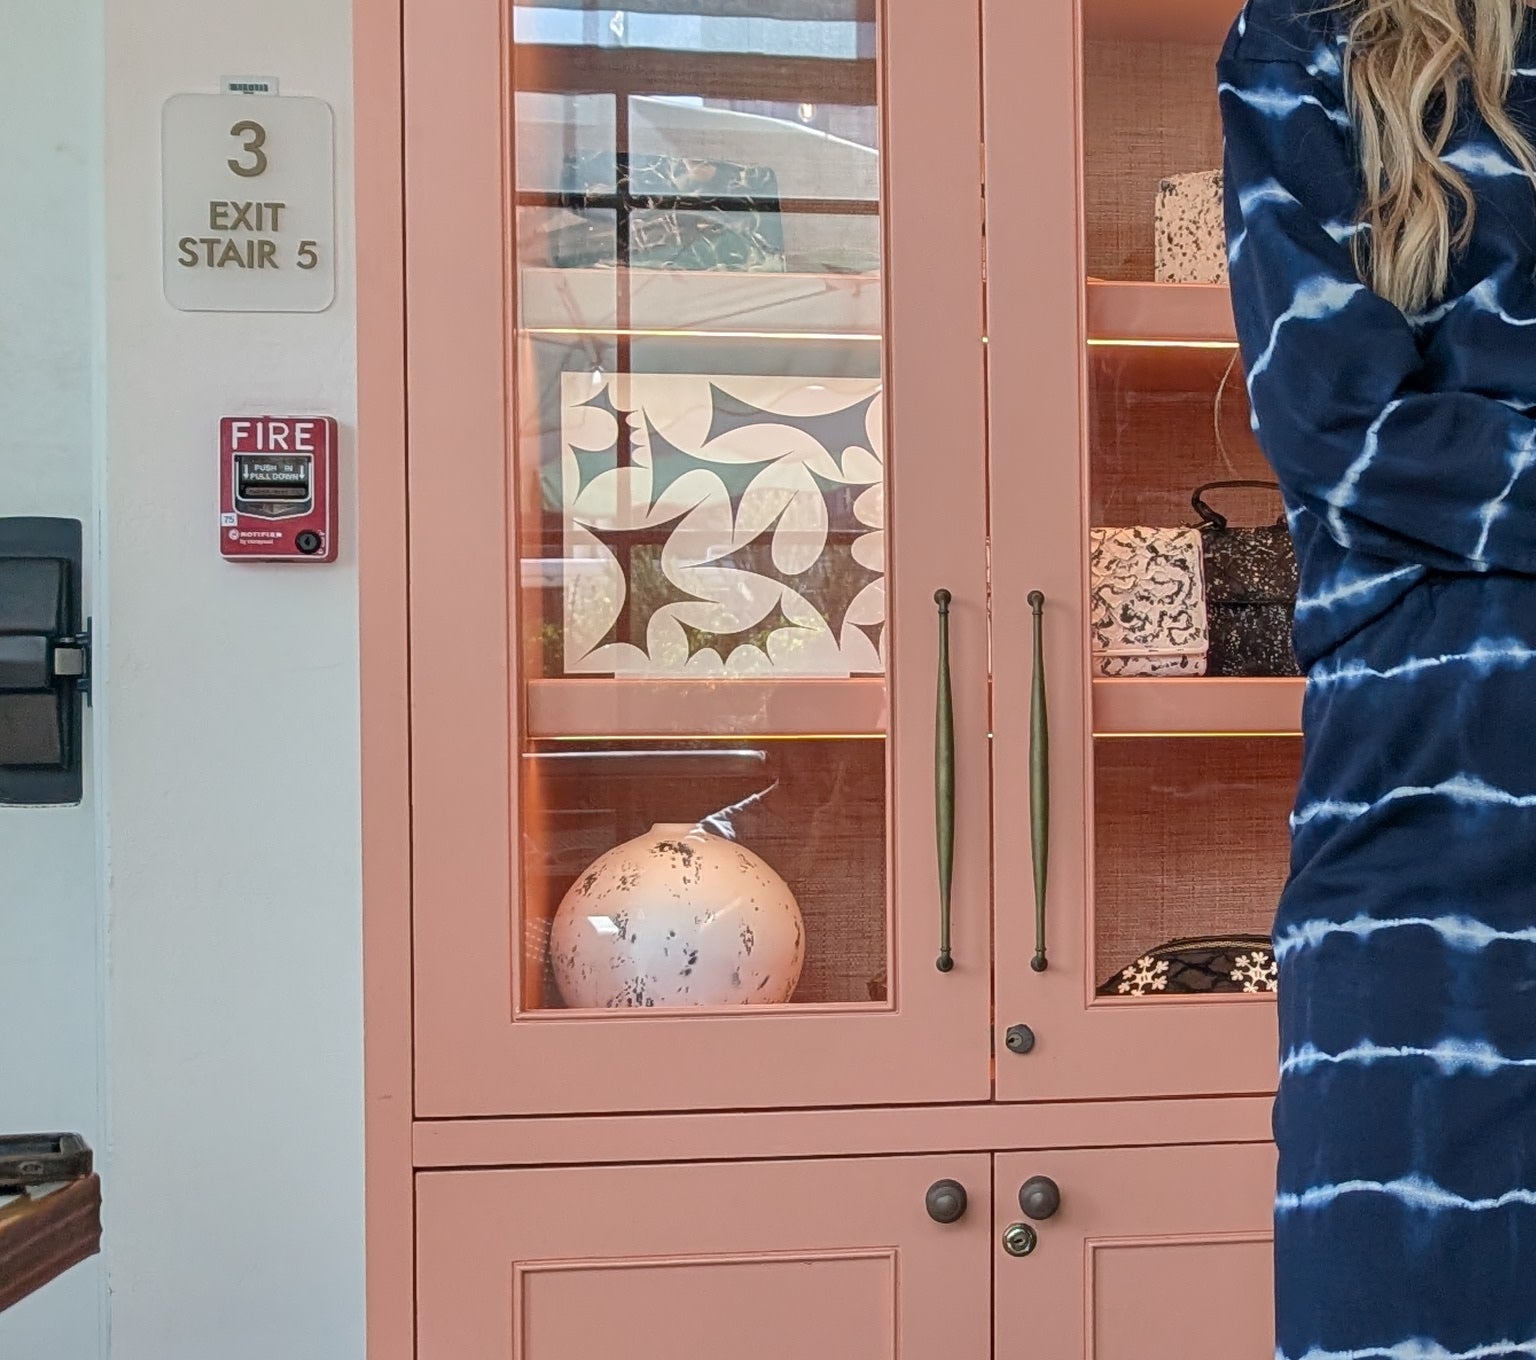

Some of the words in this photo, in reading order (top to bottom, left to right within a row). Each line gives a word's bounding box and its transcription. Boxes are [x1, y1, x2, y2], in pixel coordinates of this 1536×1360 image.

[227, 120, 268, 178] 3
[209, 200, 286, 232] EXIT
[177, 237, 280, 269] STAIR
[296, 240, 318, 270] 5
[231, 421, 314, 451] FIRE
[250, 472, 271, 480] PULL
[272, 472, 299, 480] DOWN
[223, 515, 235, 524] 75
